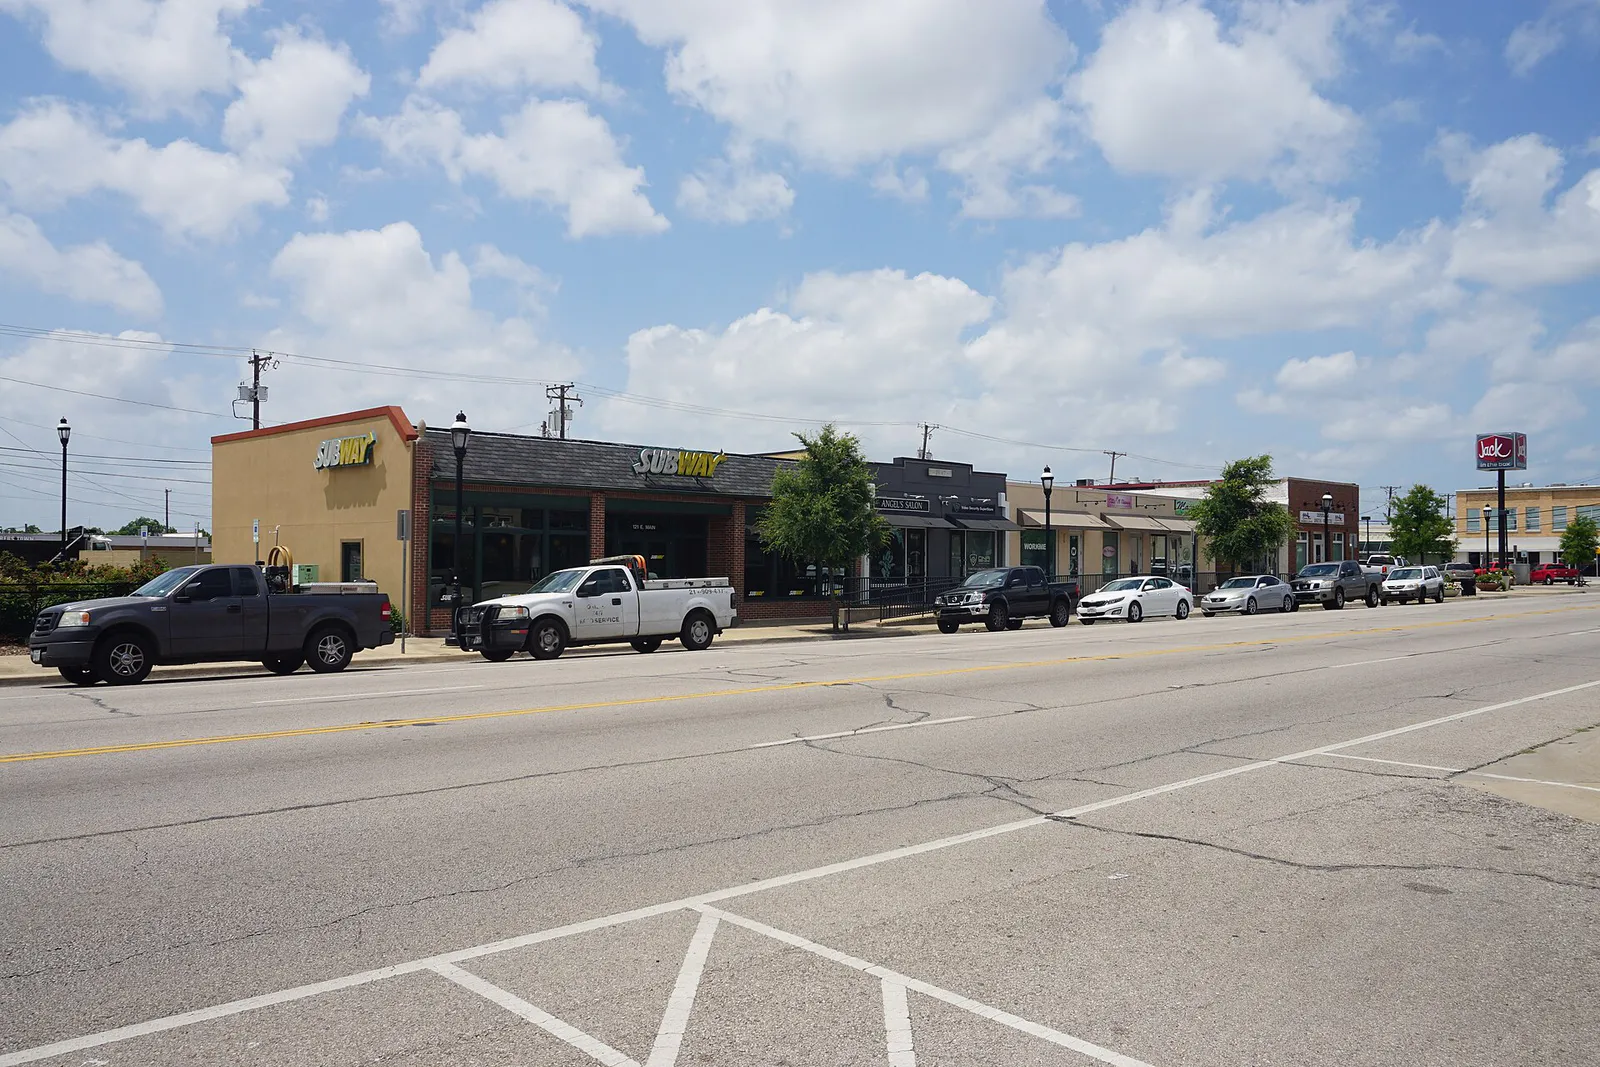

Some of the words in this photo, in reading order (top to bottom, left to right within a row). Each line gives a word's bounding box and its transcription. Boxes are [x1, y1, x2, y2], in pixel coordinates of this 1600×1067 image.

[313, 432, 376, 468] SUBWAY
[1479, 438, 1512, 458] Jack
[632, 448, 728, 477] SUBWAY
[881, 499, 904, 508] ANGEL'S
[905, 501, 923, 509] SALON
